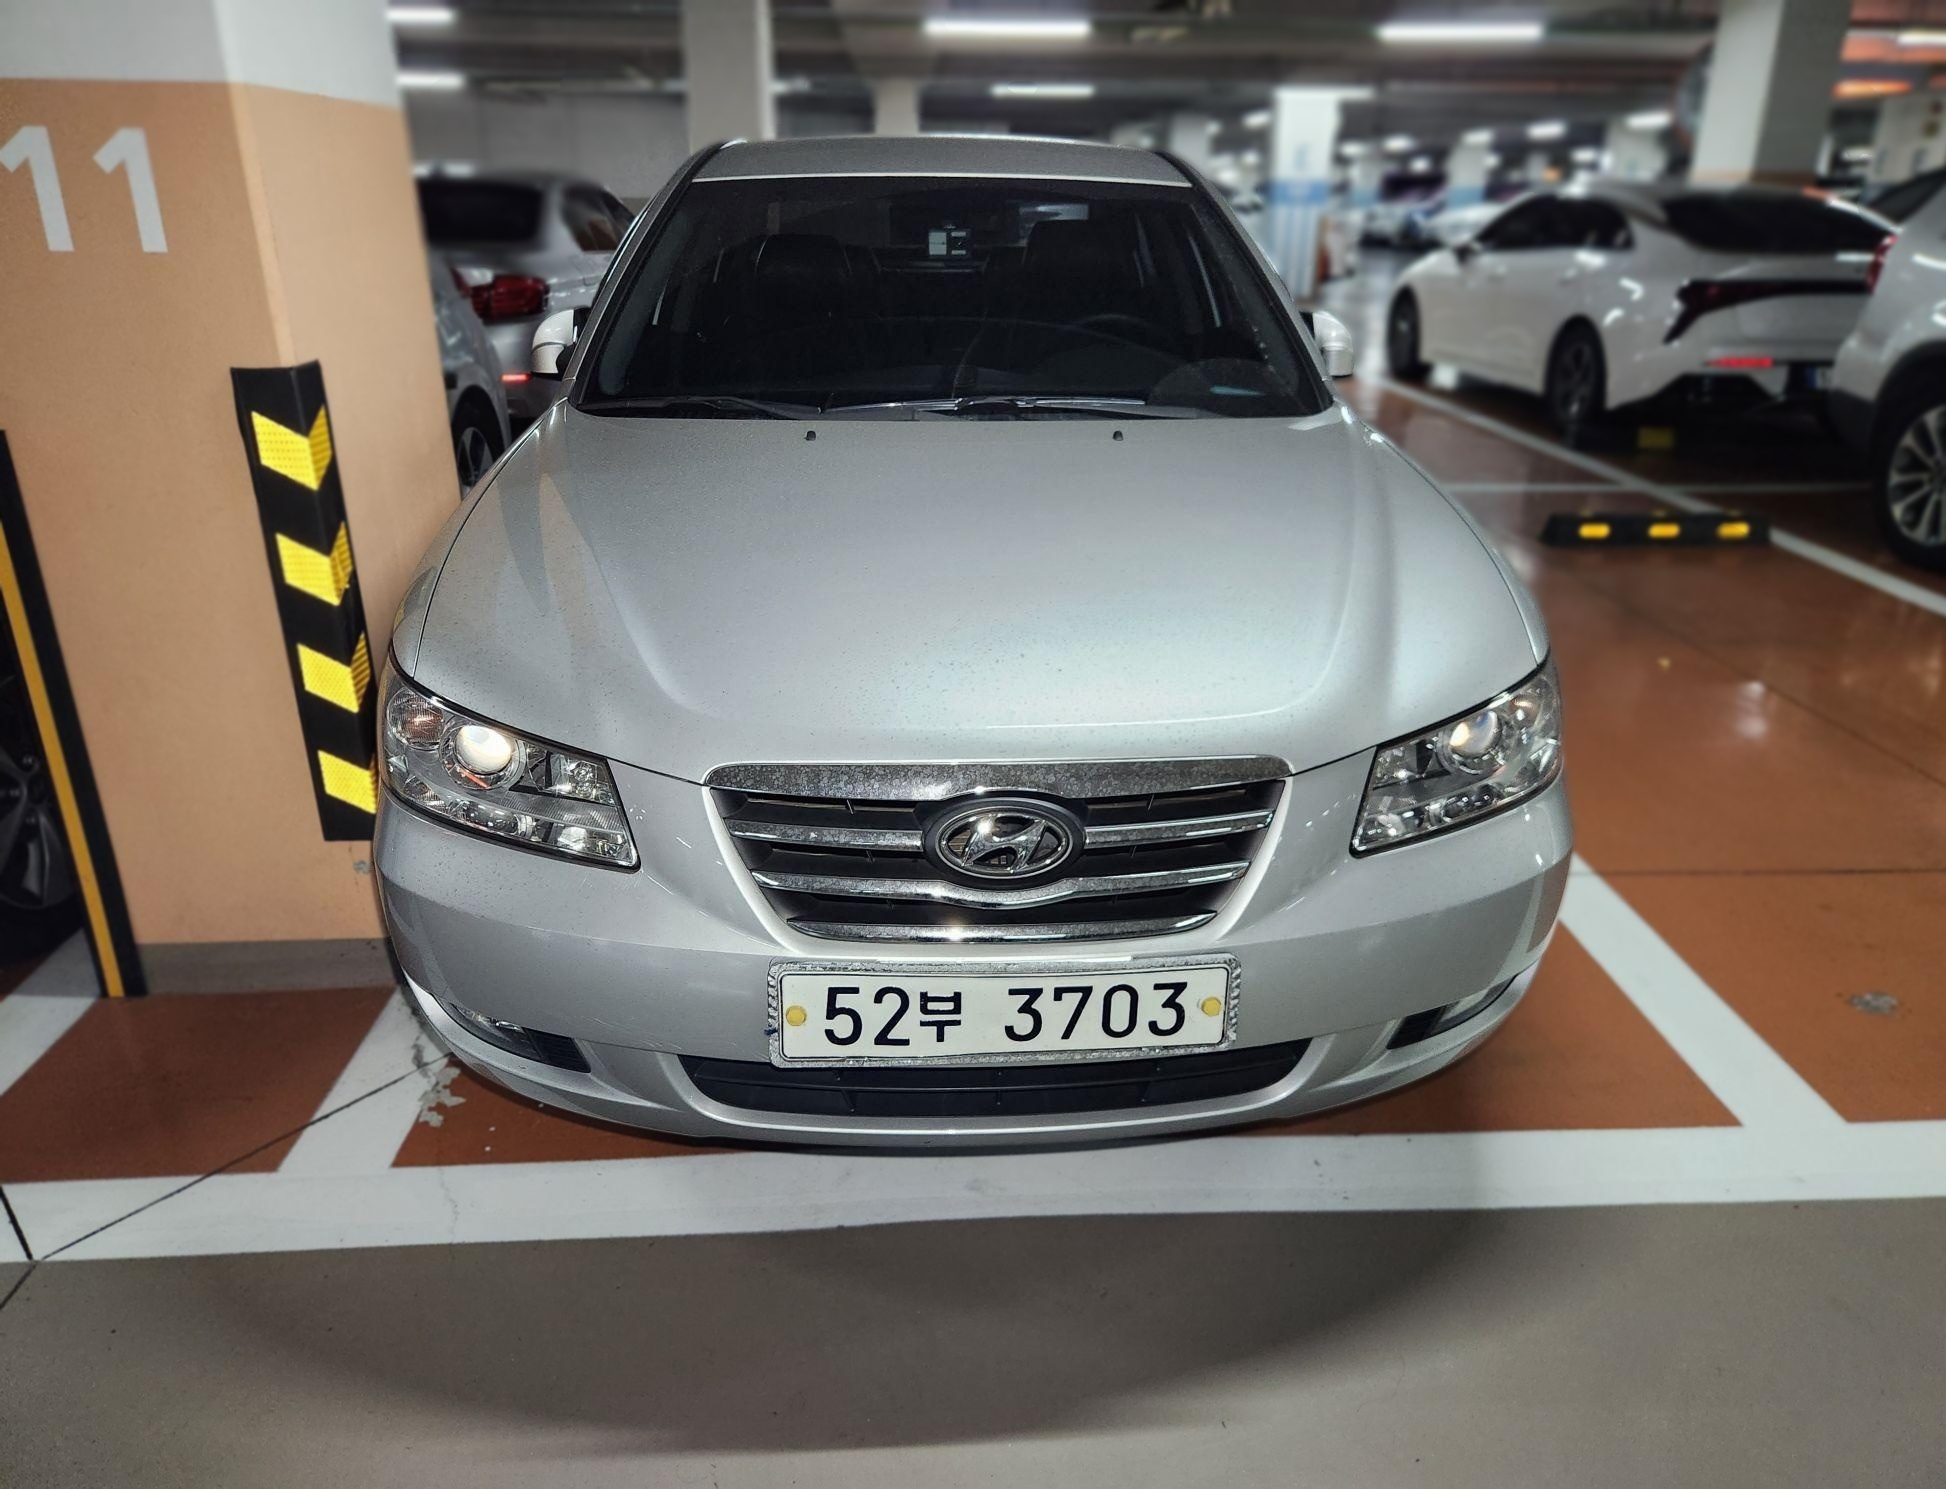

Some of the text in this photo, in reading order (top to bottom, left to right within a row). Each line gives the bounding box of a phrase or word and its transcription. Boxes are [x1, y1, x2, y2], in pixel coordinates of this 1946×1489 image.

[0, 124, 169, 253] 11
[824, 981, 1188, 1046] 52부 3703
